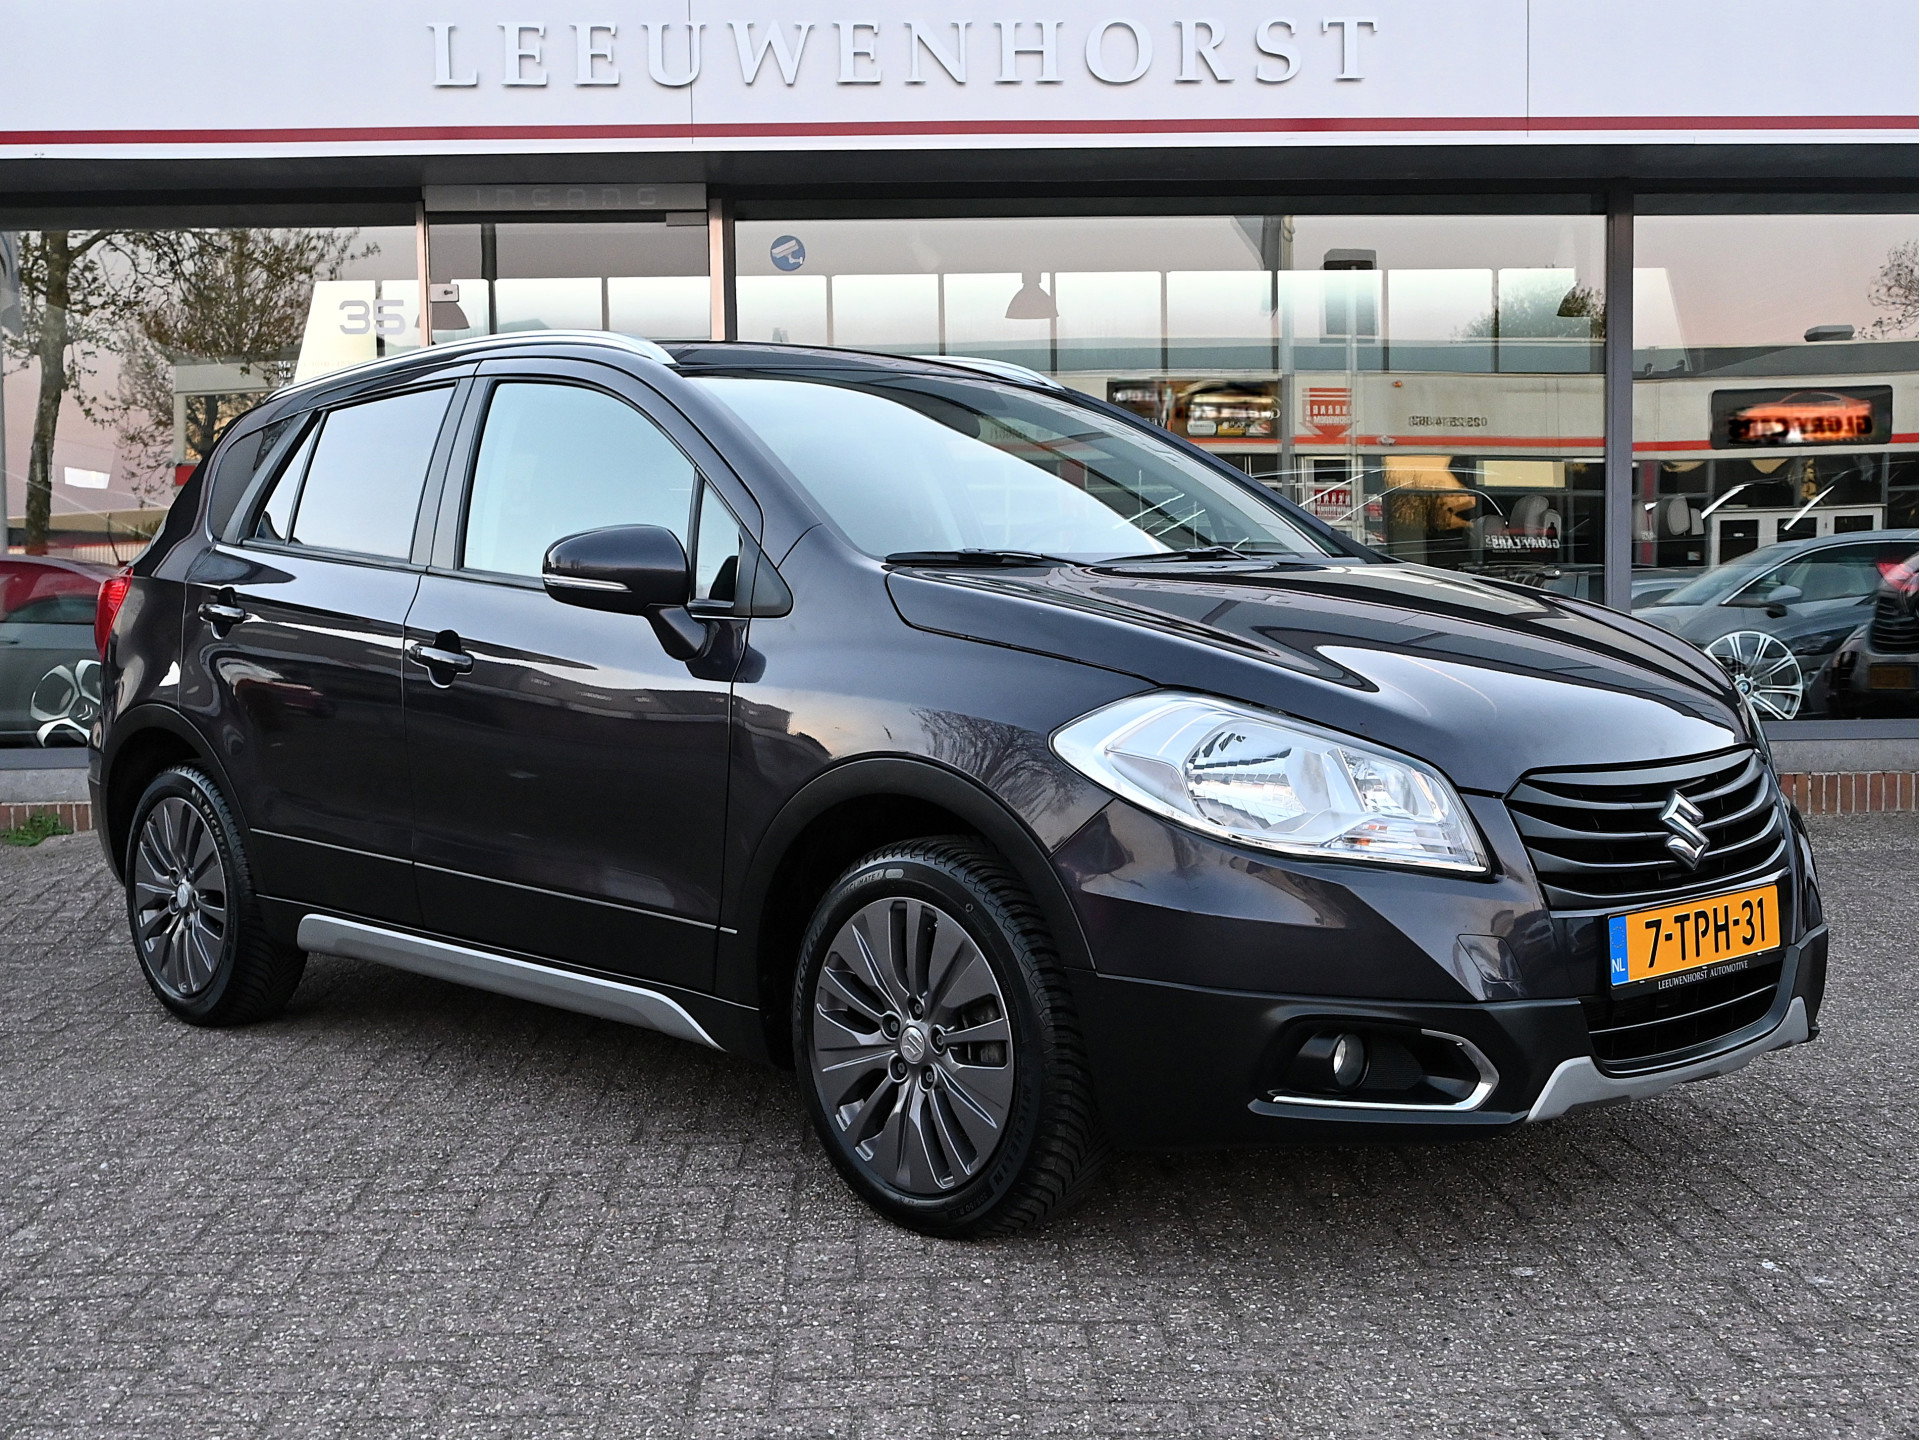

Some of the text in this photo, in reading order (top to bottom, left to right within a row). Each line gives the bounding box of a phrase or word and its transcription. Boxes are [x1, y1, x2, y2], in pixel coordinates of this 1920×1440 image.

[426, 15, 1379, 88] LEEUWENHORST
[338, 299, 406, 336] 35
[1644, 896, 1766, 969] 7-TPH-31
[1611, 957, 1626, 973] NL
[1657, 960, 1749, 990] LEEUWENHORST AUTOMOTIVE
